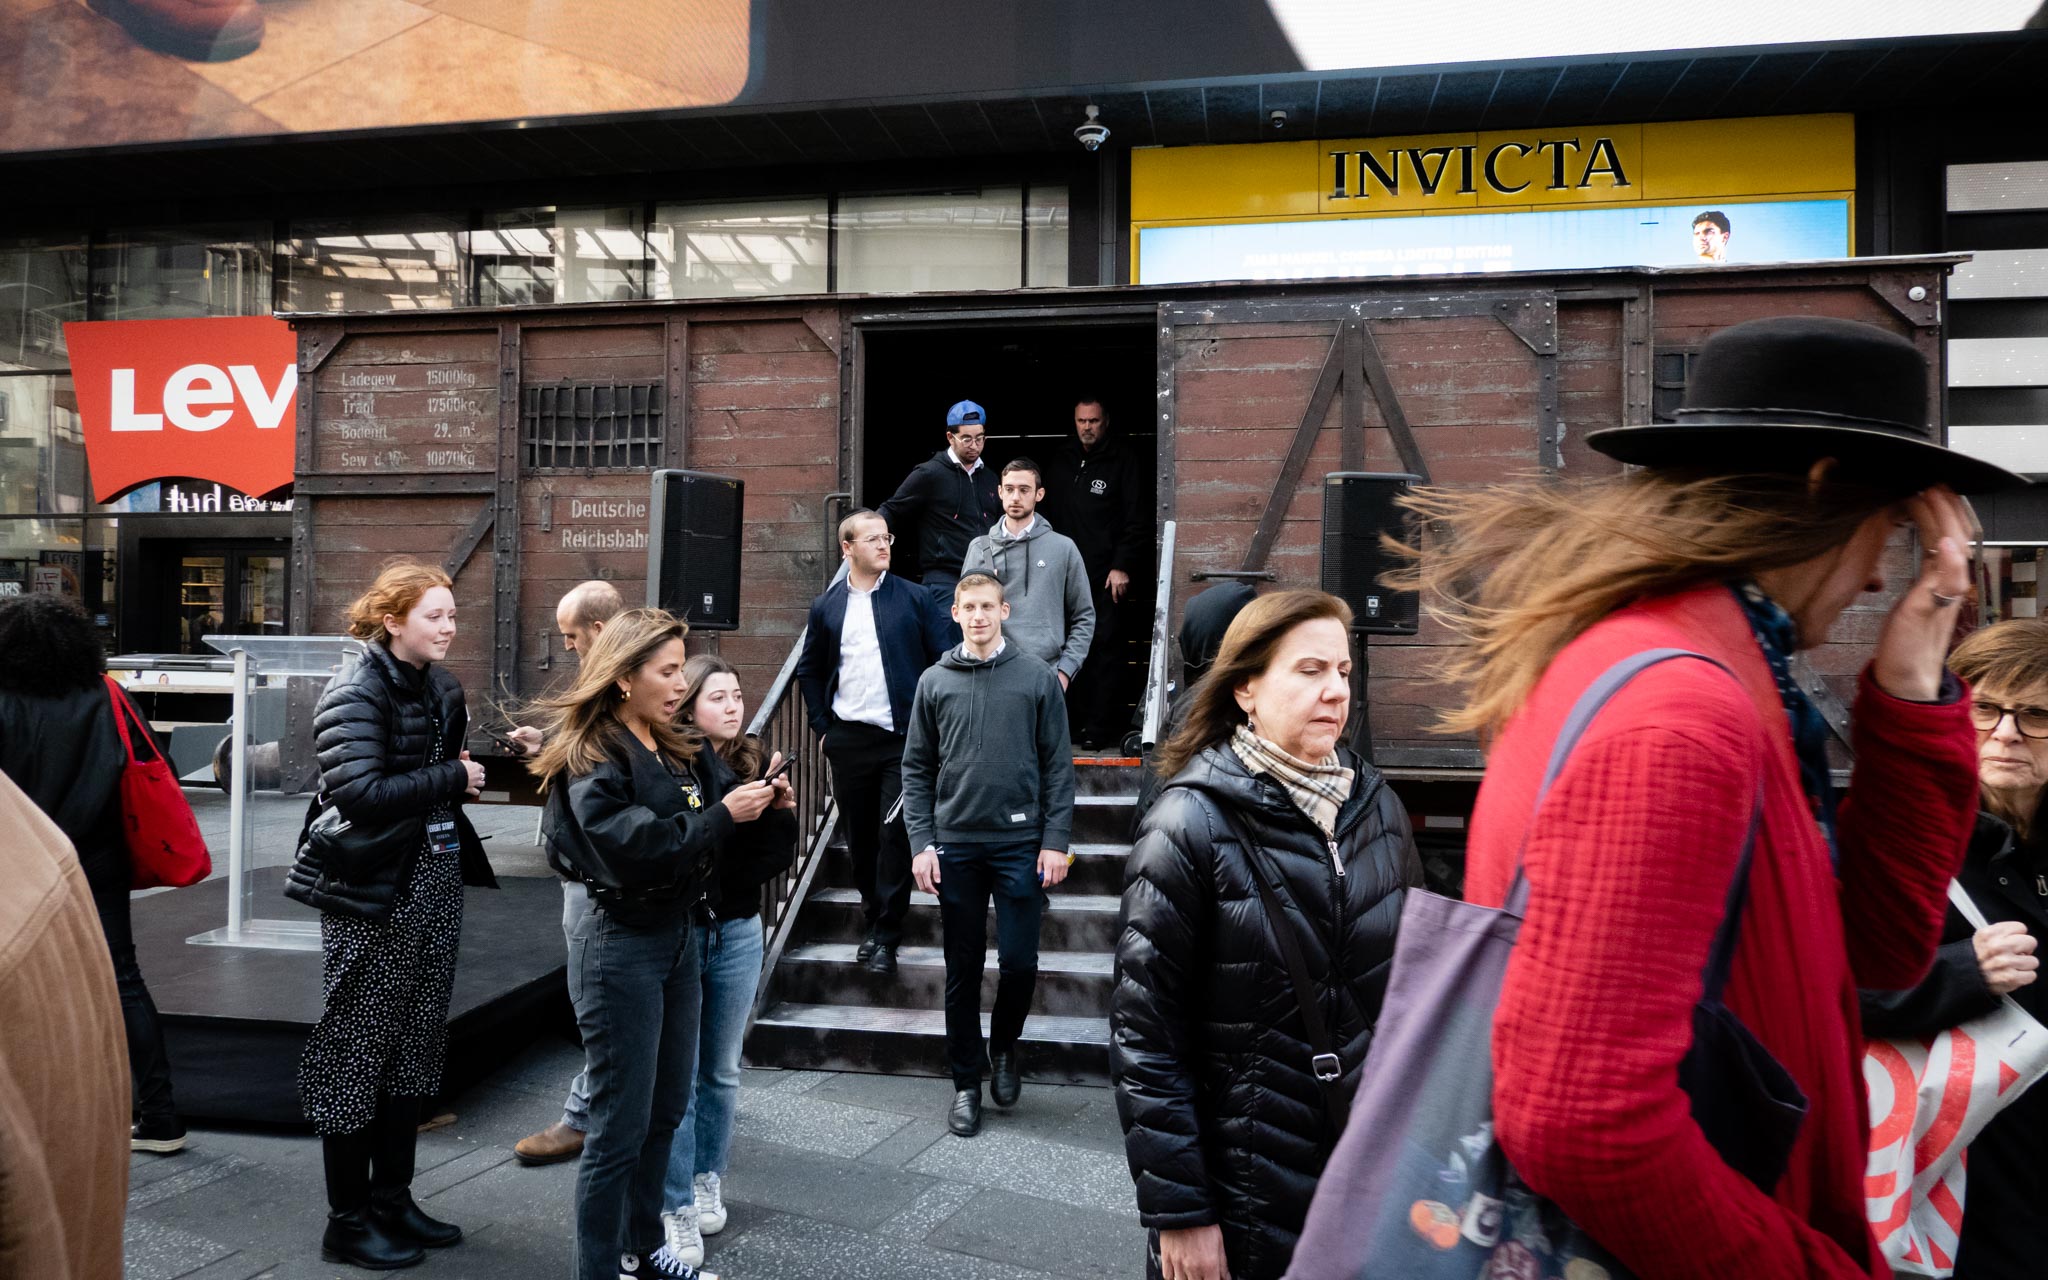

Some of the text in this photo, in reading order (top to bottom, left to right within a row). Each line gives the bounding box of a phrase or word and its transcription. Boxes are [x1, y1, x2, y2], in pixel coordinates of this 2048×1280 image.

[1329, 137, 1632, 200] INVICTA
[426, 369, 475, 388] 15000kg
[426, 451, 475, 469] 10870kg
[571, 500, 646, 519] Deutsche
